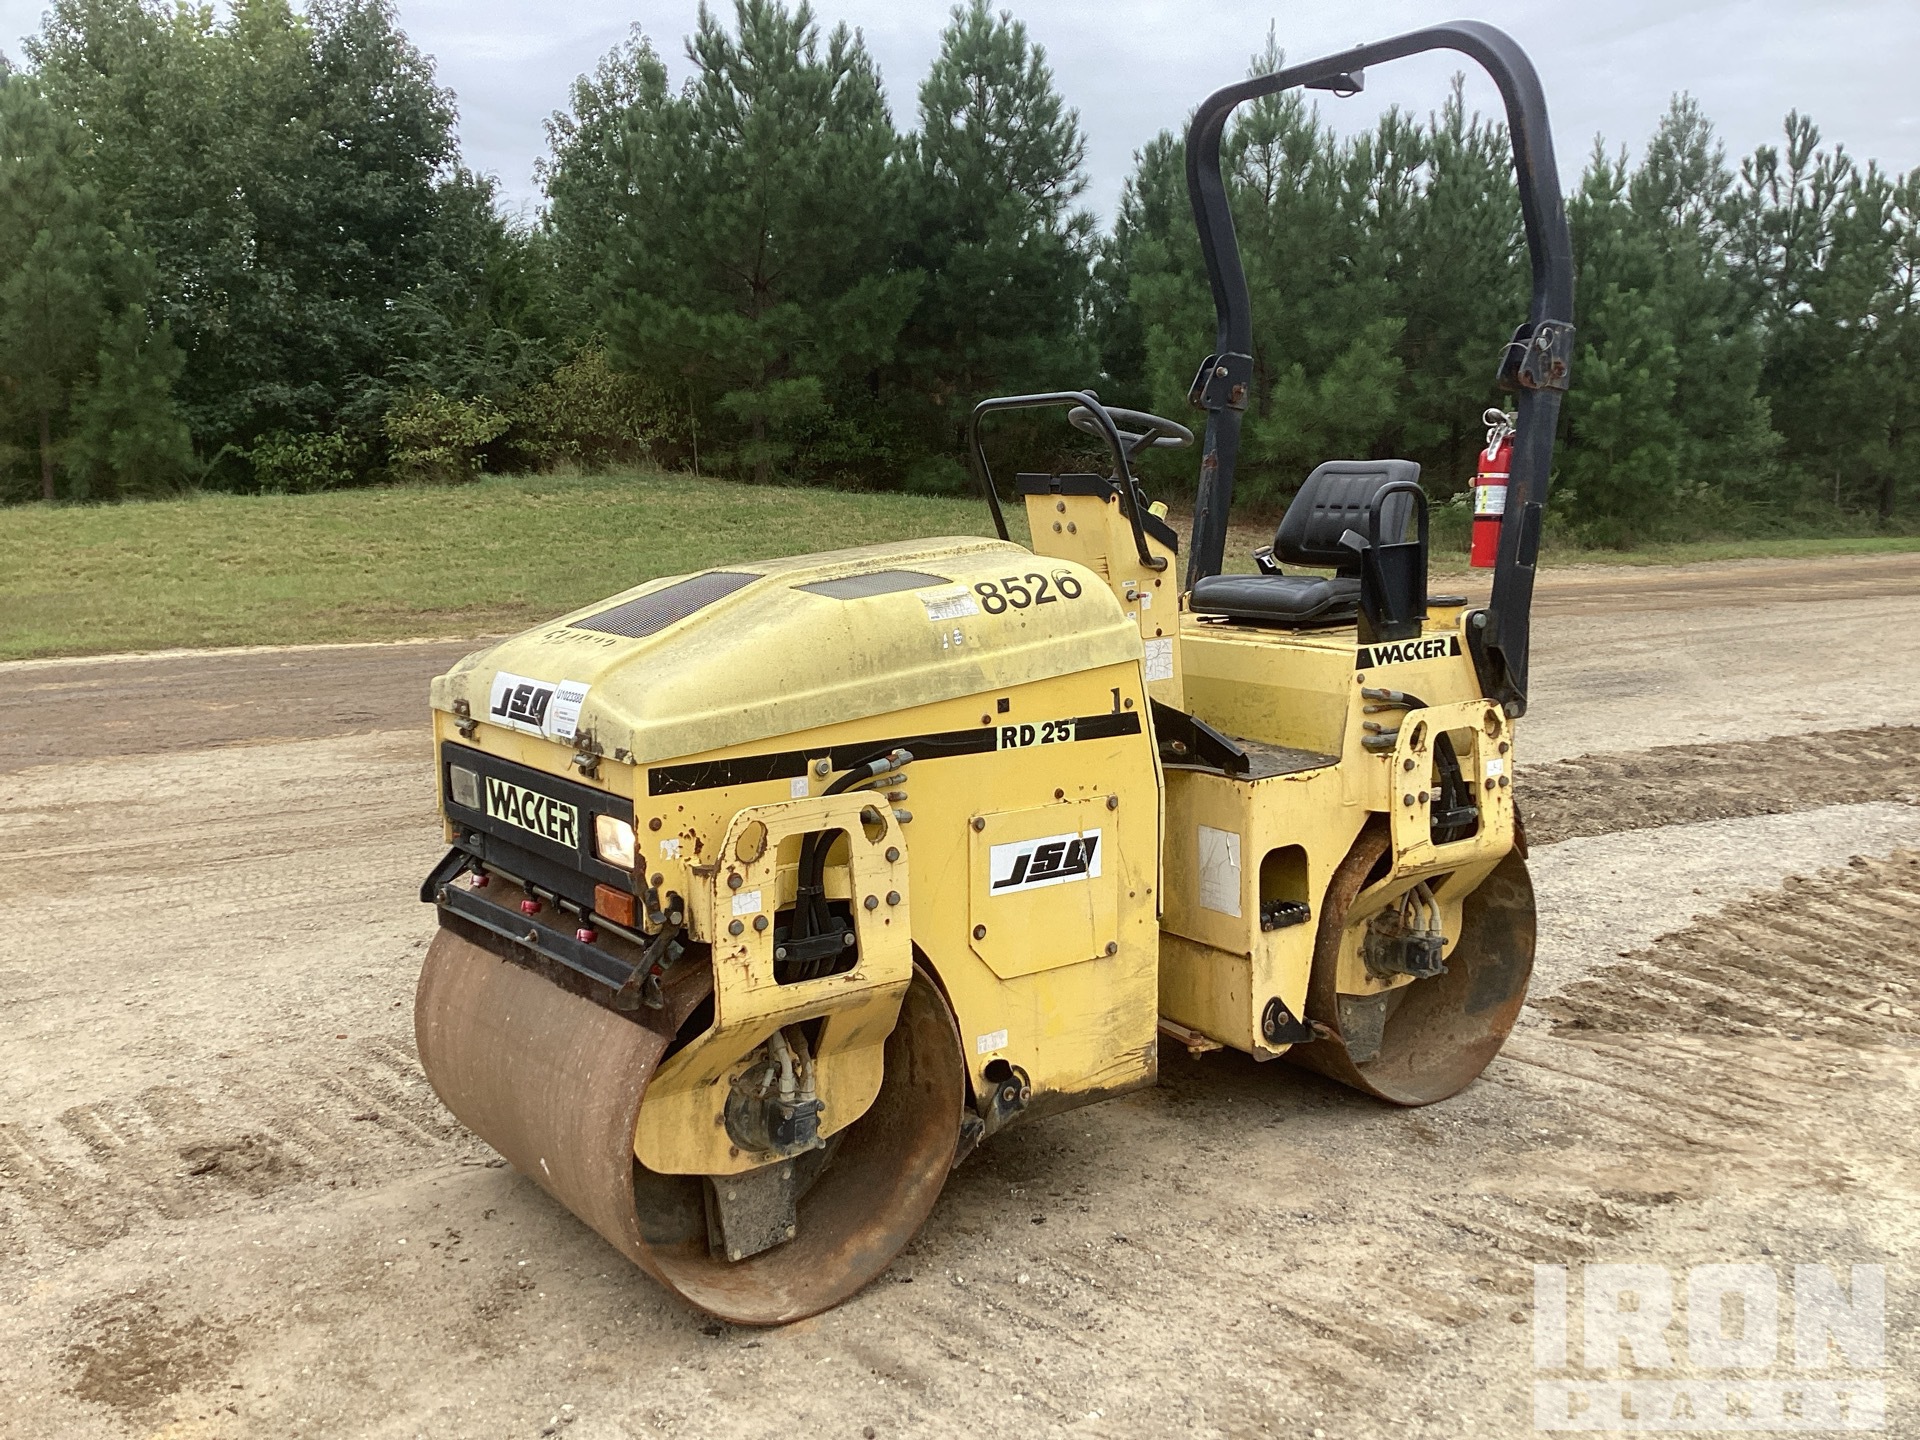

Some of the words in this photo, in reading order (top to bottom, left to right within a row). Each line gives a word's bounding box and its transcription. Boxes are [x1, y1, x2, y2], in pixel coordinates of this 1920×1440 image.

[974, 568, 1082, 615] 8526
[1373, 638, 1447, 666] WACKER
[1001, 724, 1036, 749] RD
[1041, 720, 1071, 744] 25
[487, 777, 577, 848] WACKER
